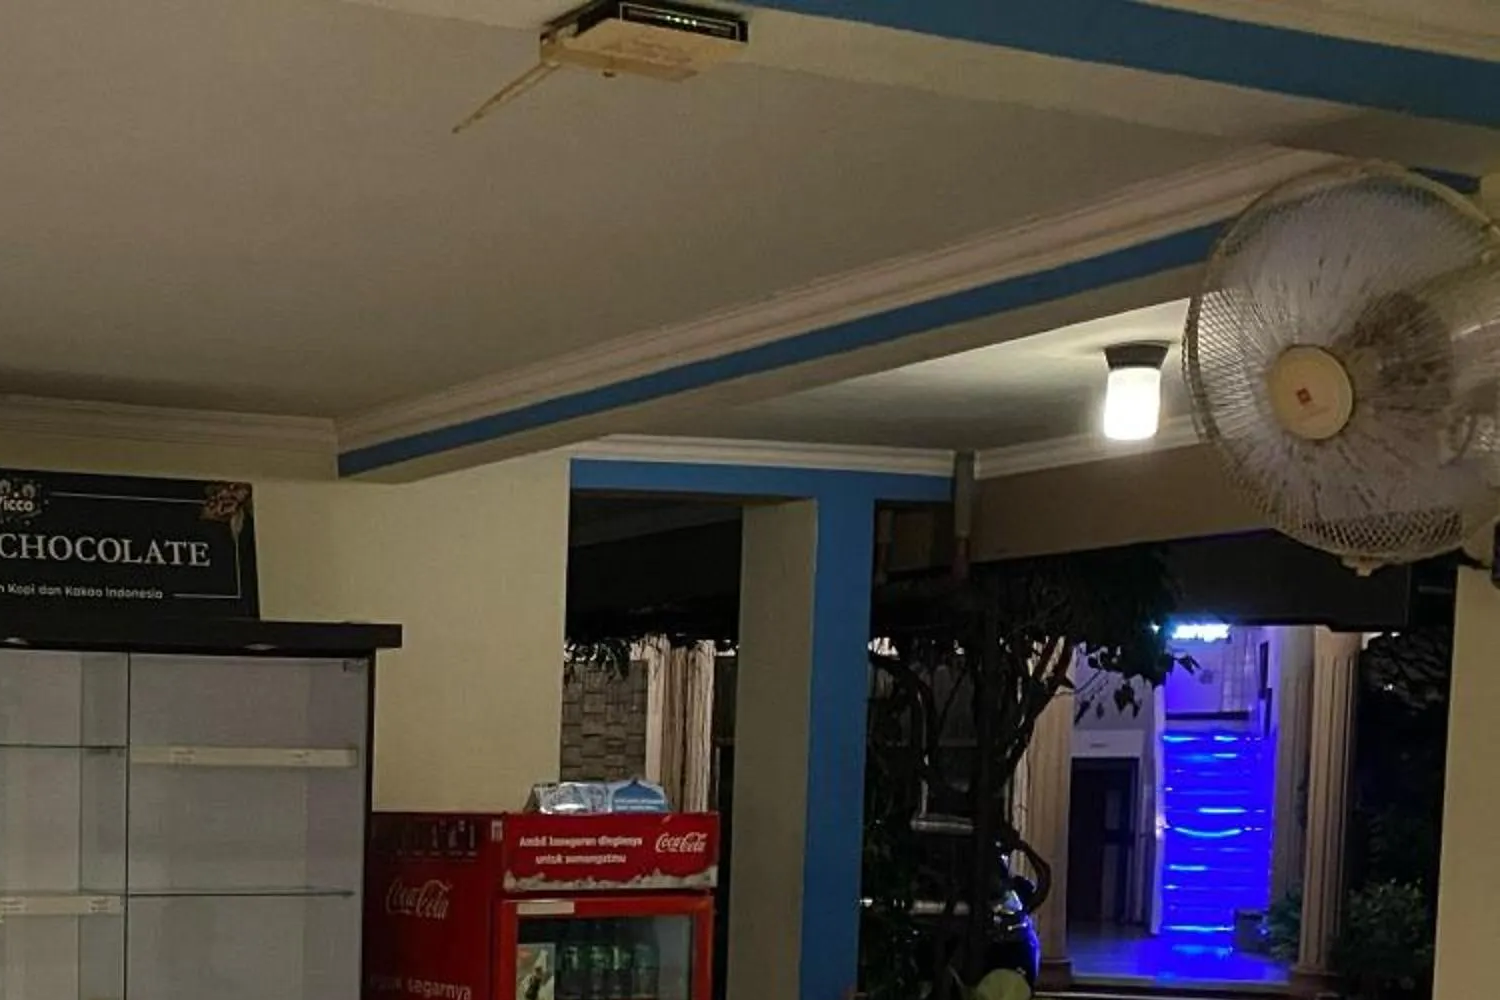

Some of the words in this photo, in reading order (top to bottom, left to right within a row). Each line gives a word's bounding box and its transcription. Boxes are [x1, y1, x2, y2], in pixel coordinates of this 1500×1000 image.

[7, 583, 35, 597] Kopi
[38, 584, 62, 596] dan
[64, 586, 103, 598] Kakao
[105, 587, 164, 600] Indonesia
